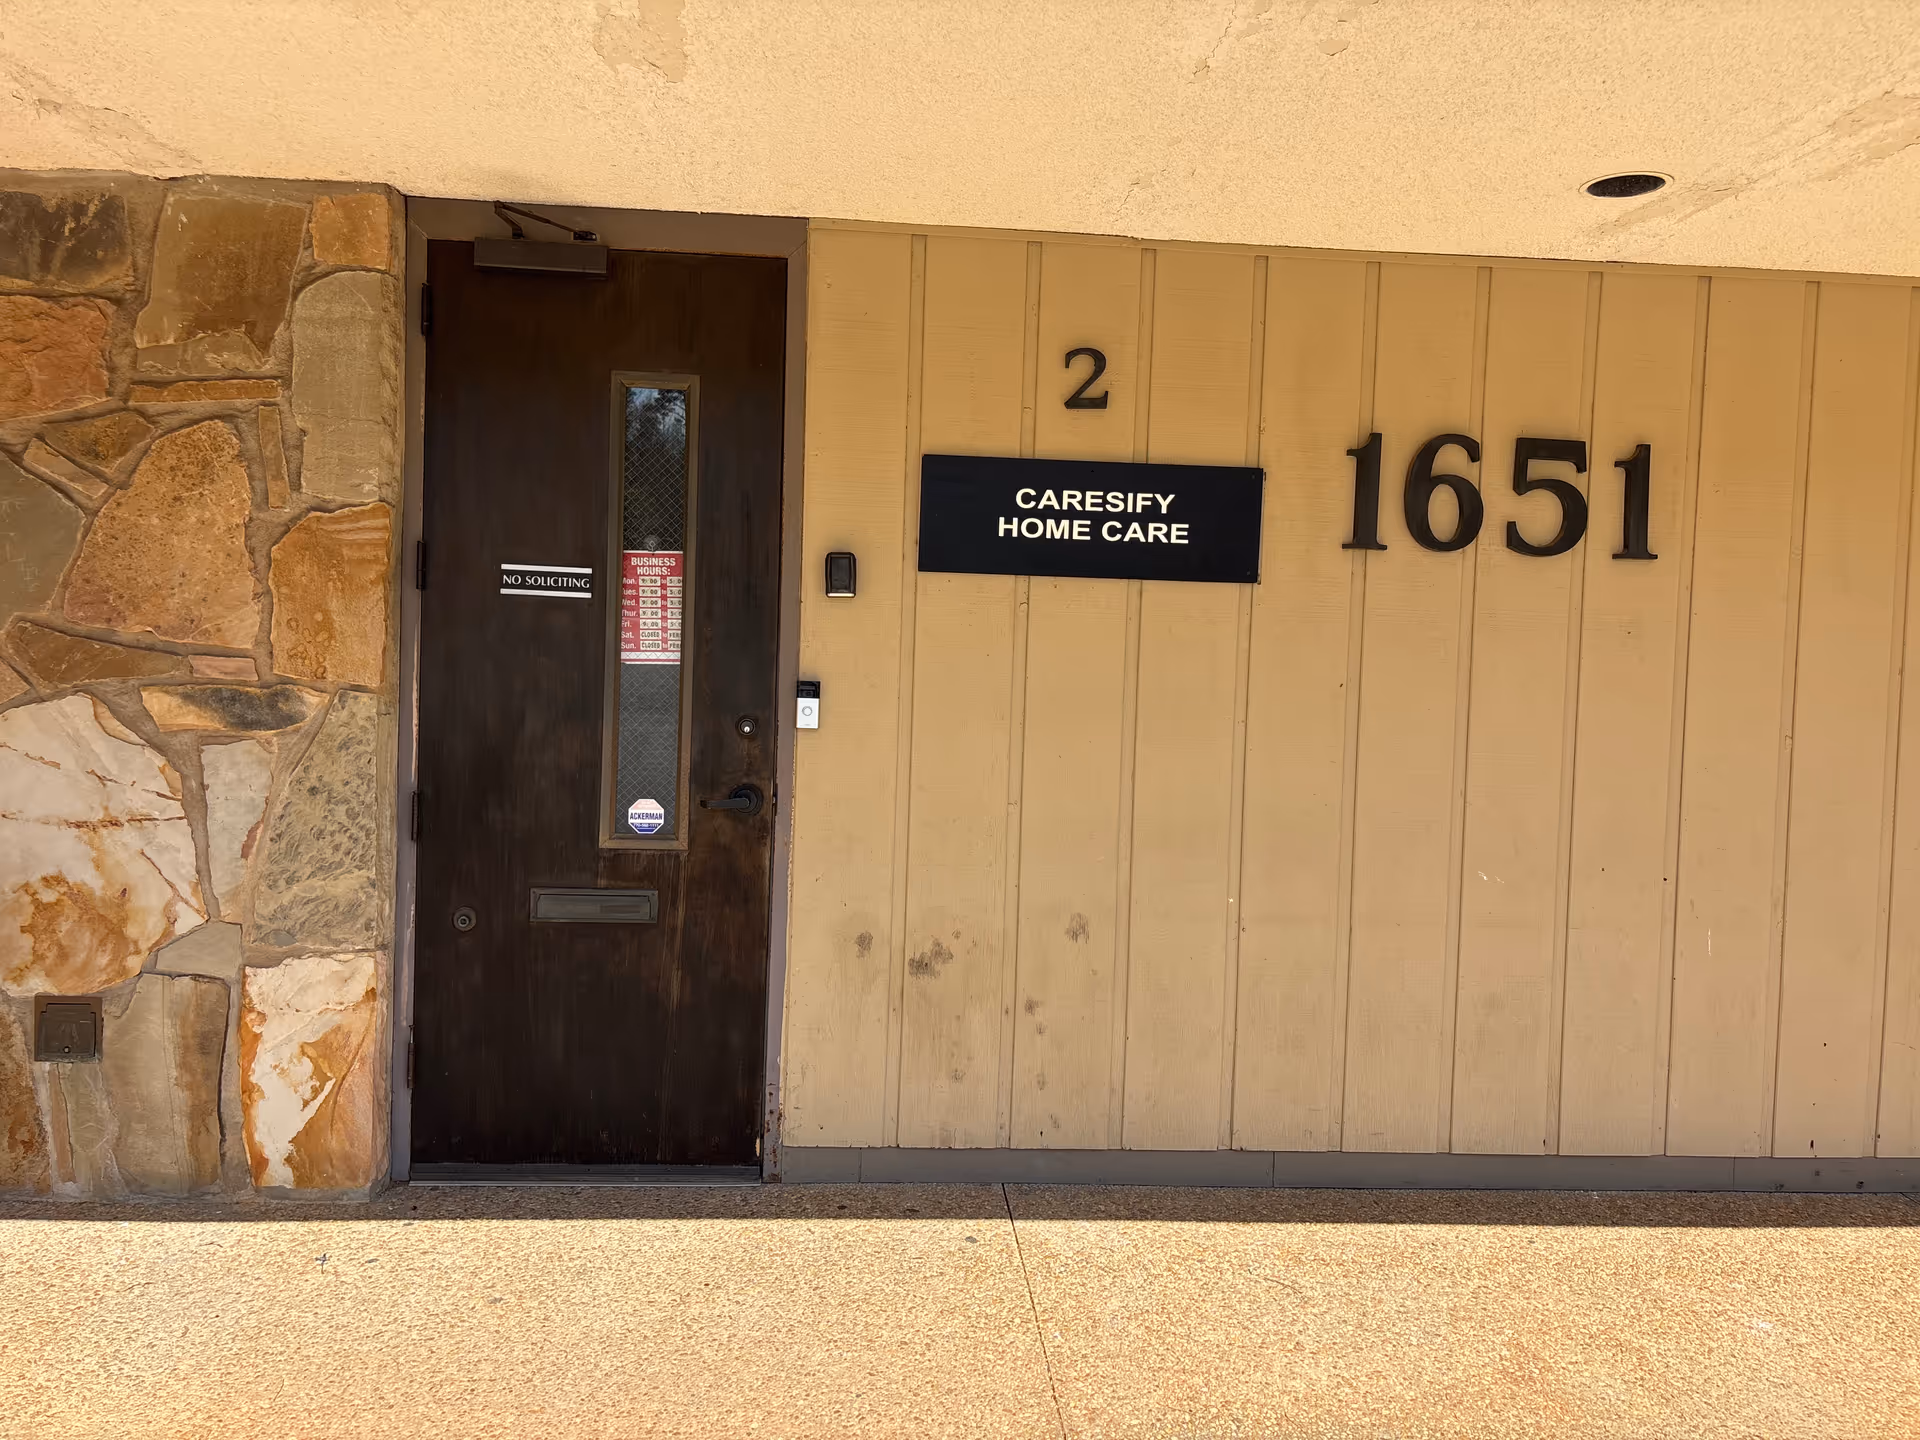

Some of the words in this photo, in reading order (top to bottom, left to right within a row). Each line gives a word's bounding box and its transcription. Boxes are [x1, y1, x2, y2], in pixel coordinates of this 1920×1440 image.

[1063, 347, 1109, 410] 2
[1015, 487, 1175, 514] CARESIFY
[1341, 432, 1659, 560] 1651
[998, 516, 1092, 541] HOME
[1101, 520, 1190, 544] CARE
[631, 557, 676, 566] BUSINESS
[637, 566, 671, 575] HOURS:
[502, 574, 522, 585] NO
[525, 575, 590, 588] SOLICITING
[621, 631, 634, 639] Sat.
[630, 812, 663, 820] ACKERMAN
